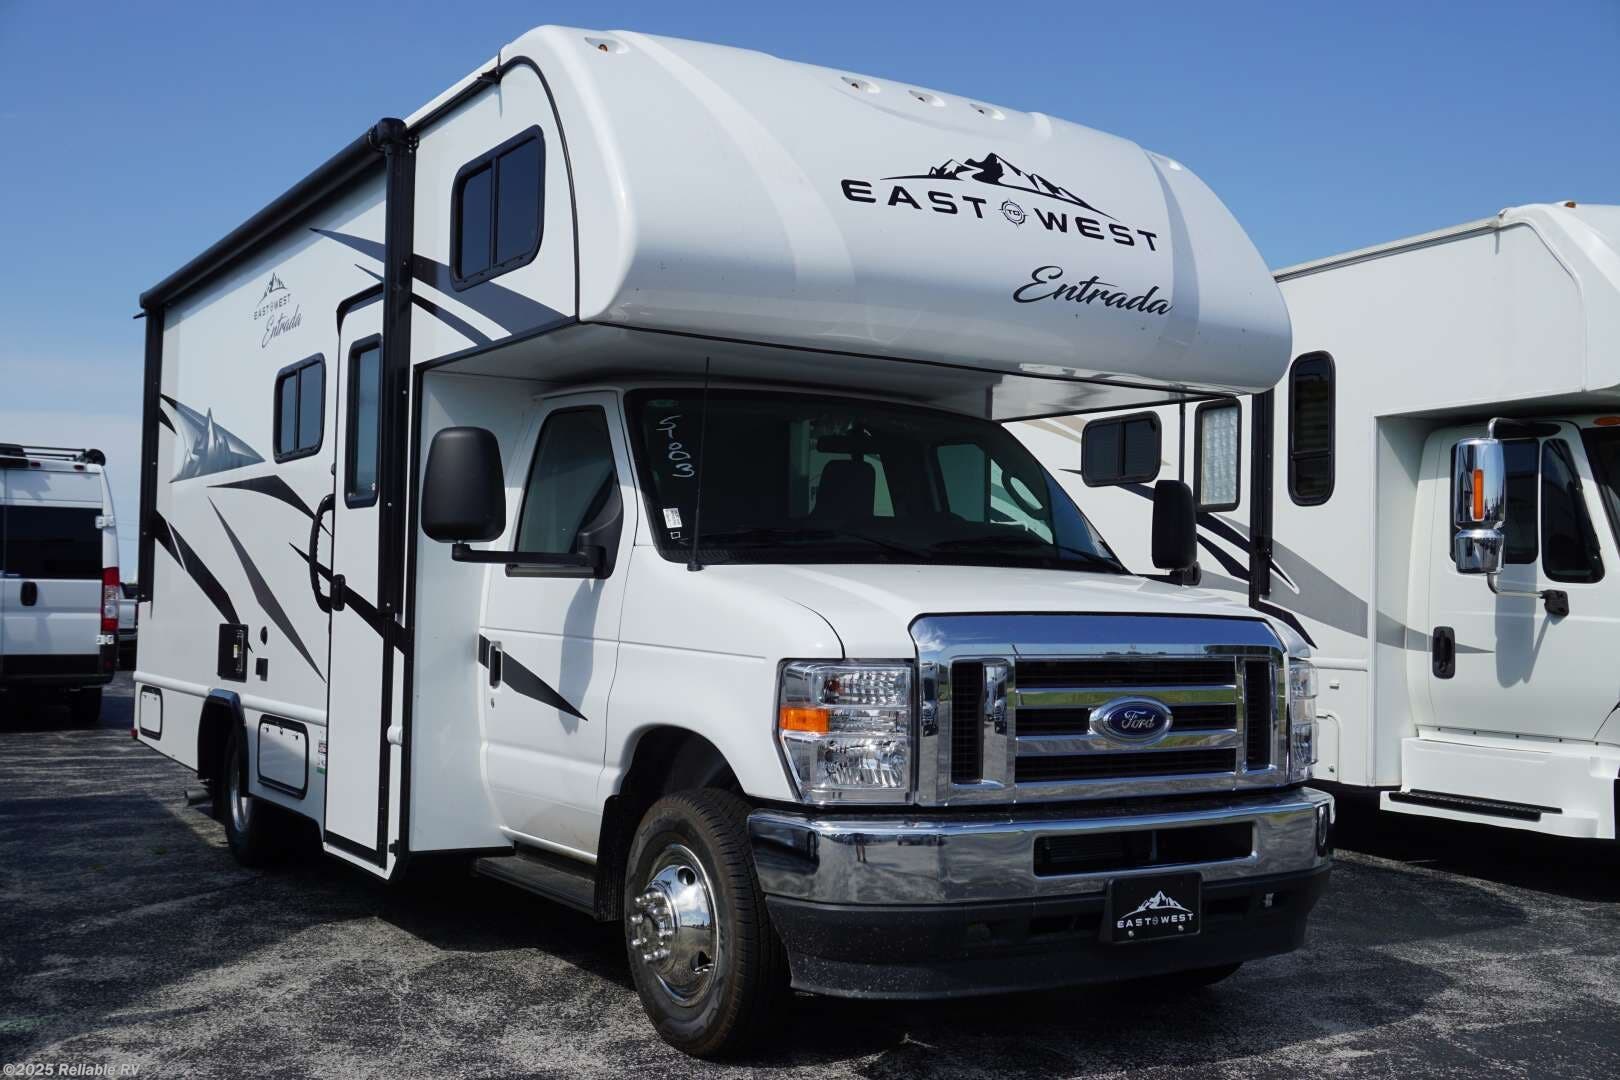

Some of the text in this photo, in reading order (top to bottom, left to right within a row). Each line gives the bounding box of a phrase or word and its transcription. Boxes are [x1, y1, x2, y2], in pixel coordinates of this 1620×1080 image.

[841, 178, 988, 219] EAST
[1033, 207, 1158, 252] WEST
[1012, 265, 1173, 316] Entrada
[1121, 710, 1156, 729] Ford
[1116, 917, 1152, 929] EAST
[1160, 913, 1194, 924] WEST
